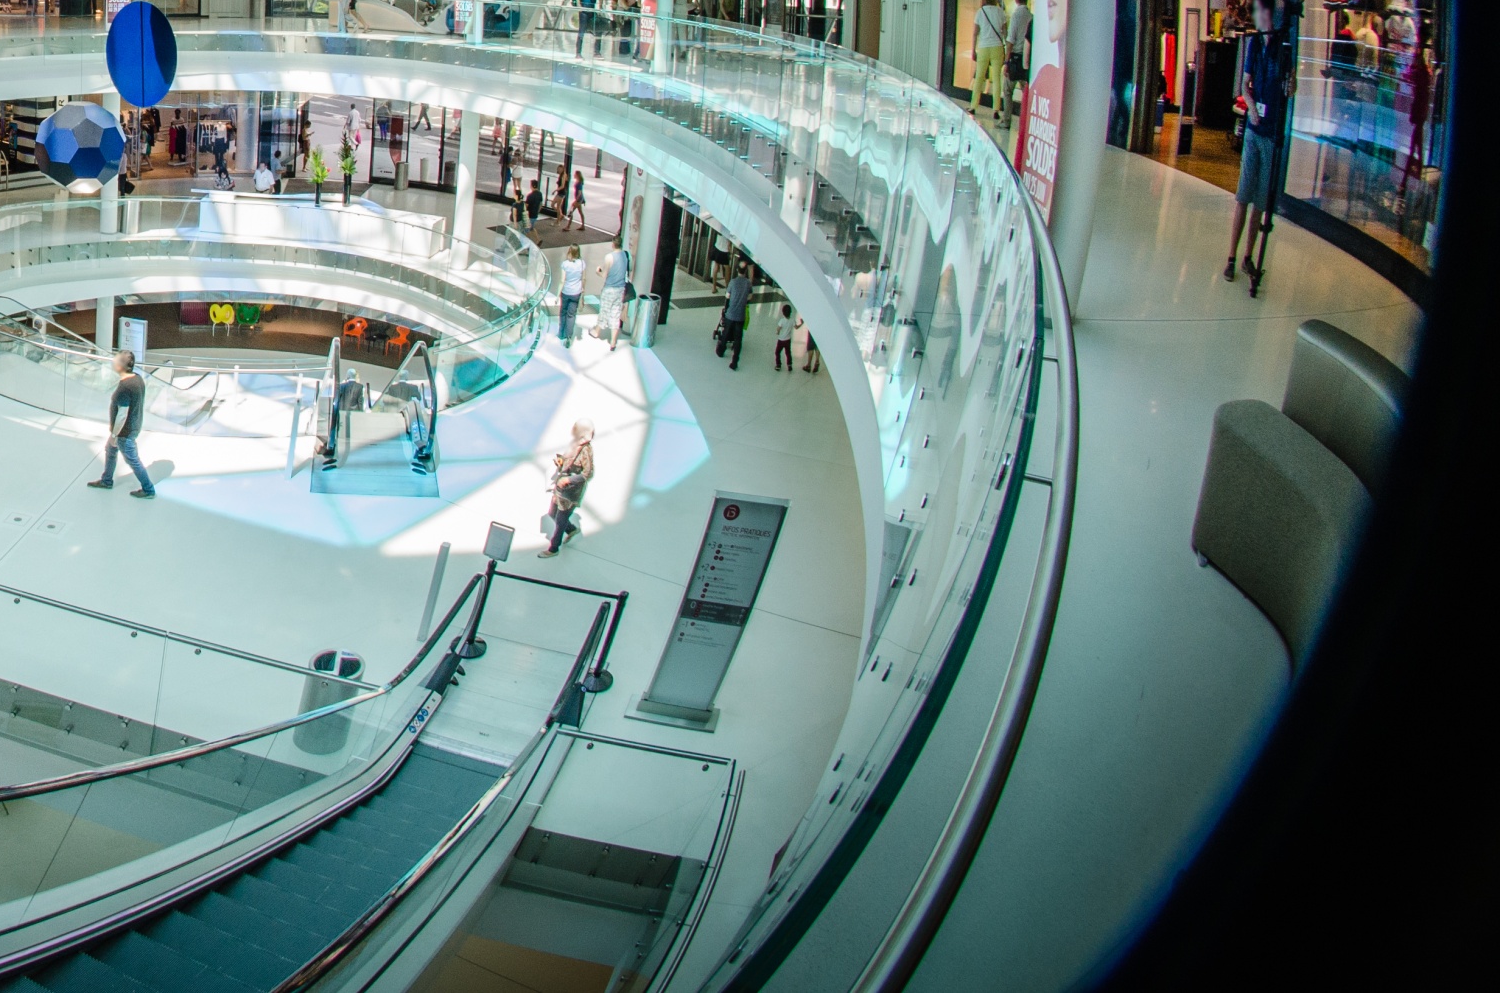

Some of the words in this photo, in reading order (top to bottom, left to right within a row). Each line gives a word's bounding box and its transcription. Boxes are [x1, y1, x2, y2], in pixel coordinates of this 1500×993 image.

[1030, 89, 1037, 114] À
[1038, 95, 1050, 119] VOS
[722, 526, 739, 534] INFOS
[740, 528, 772, 537] PRATIQUES
